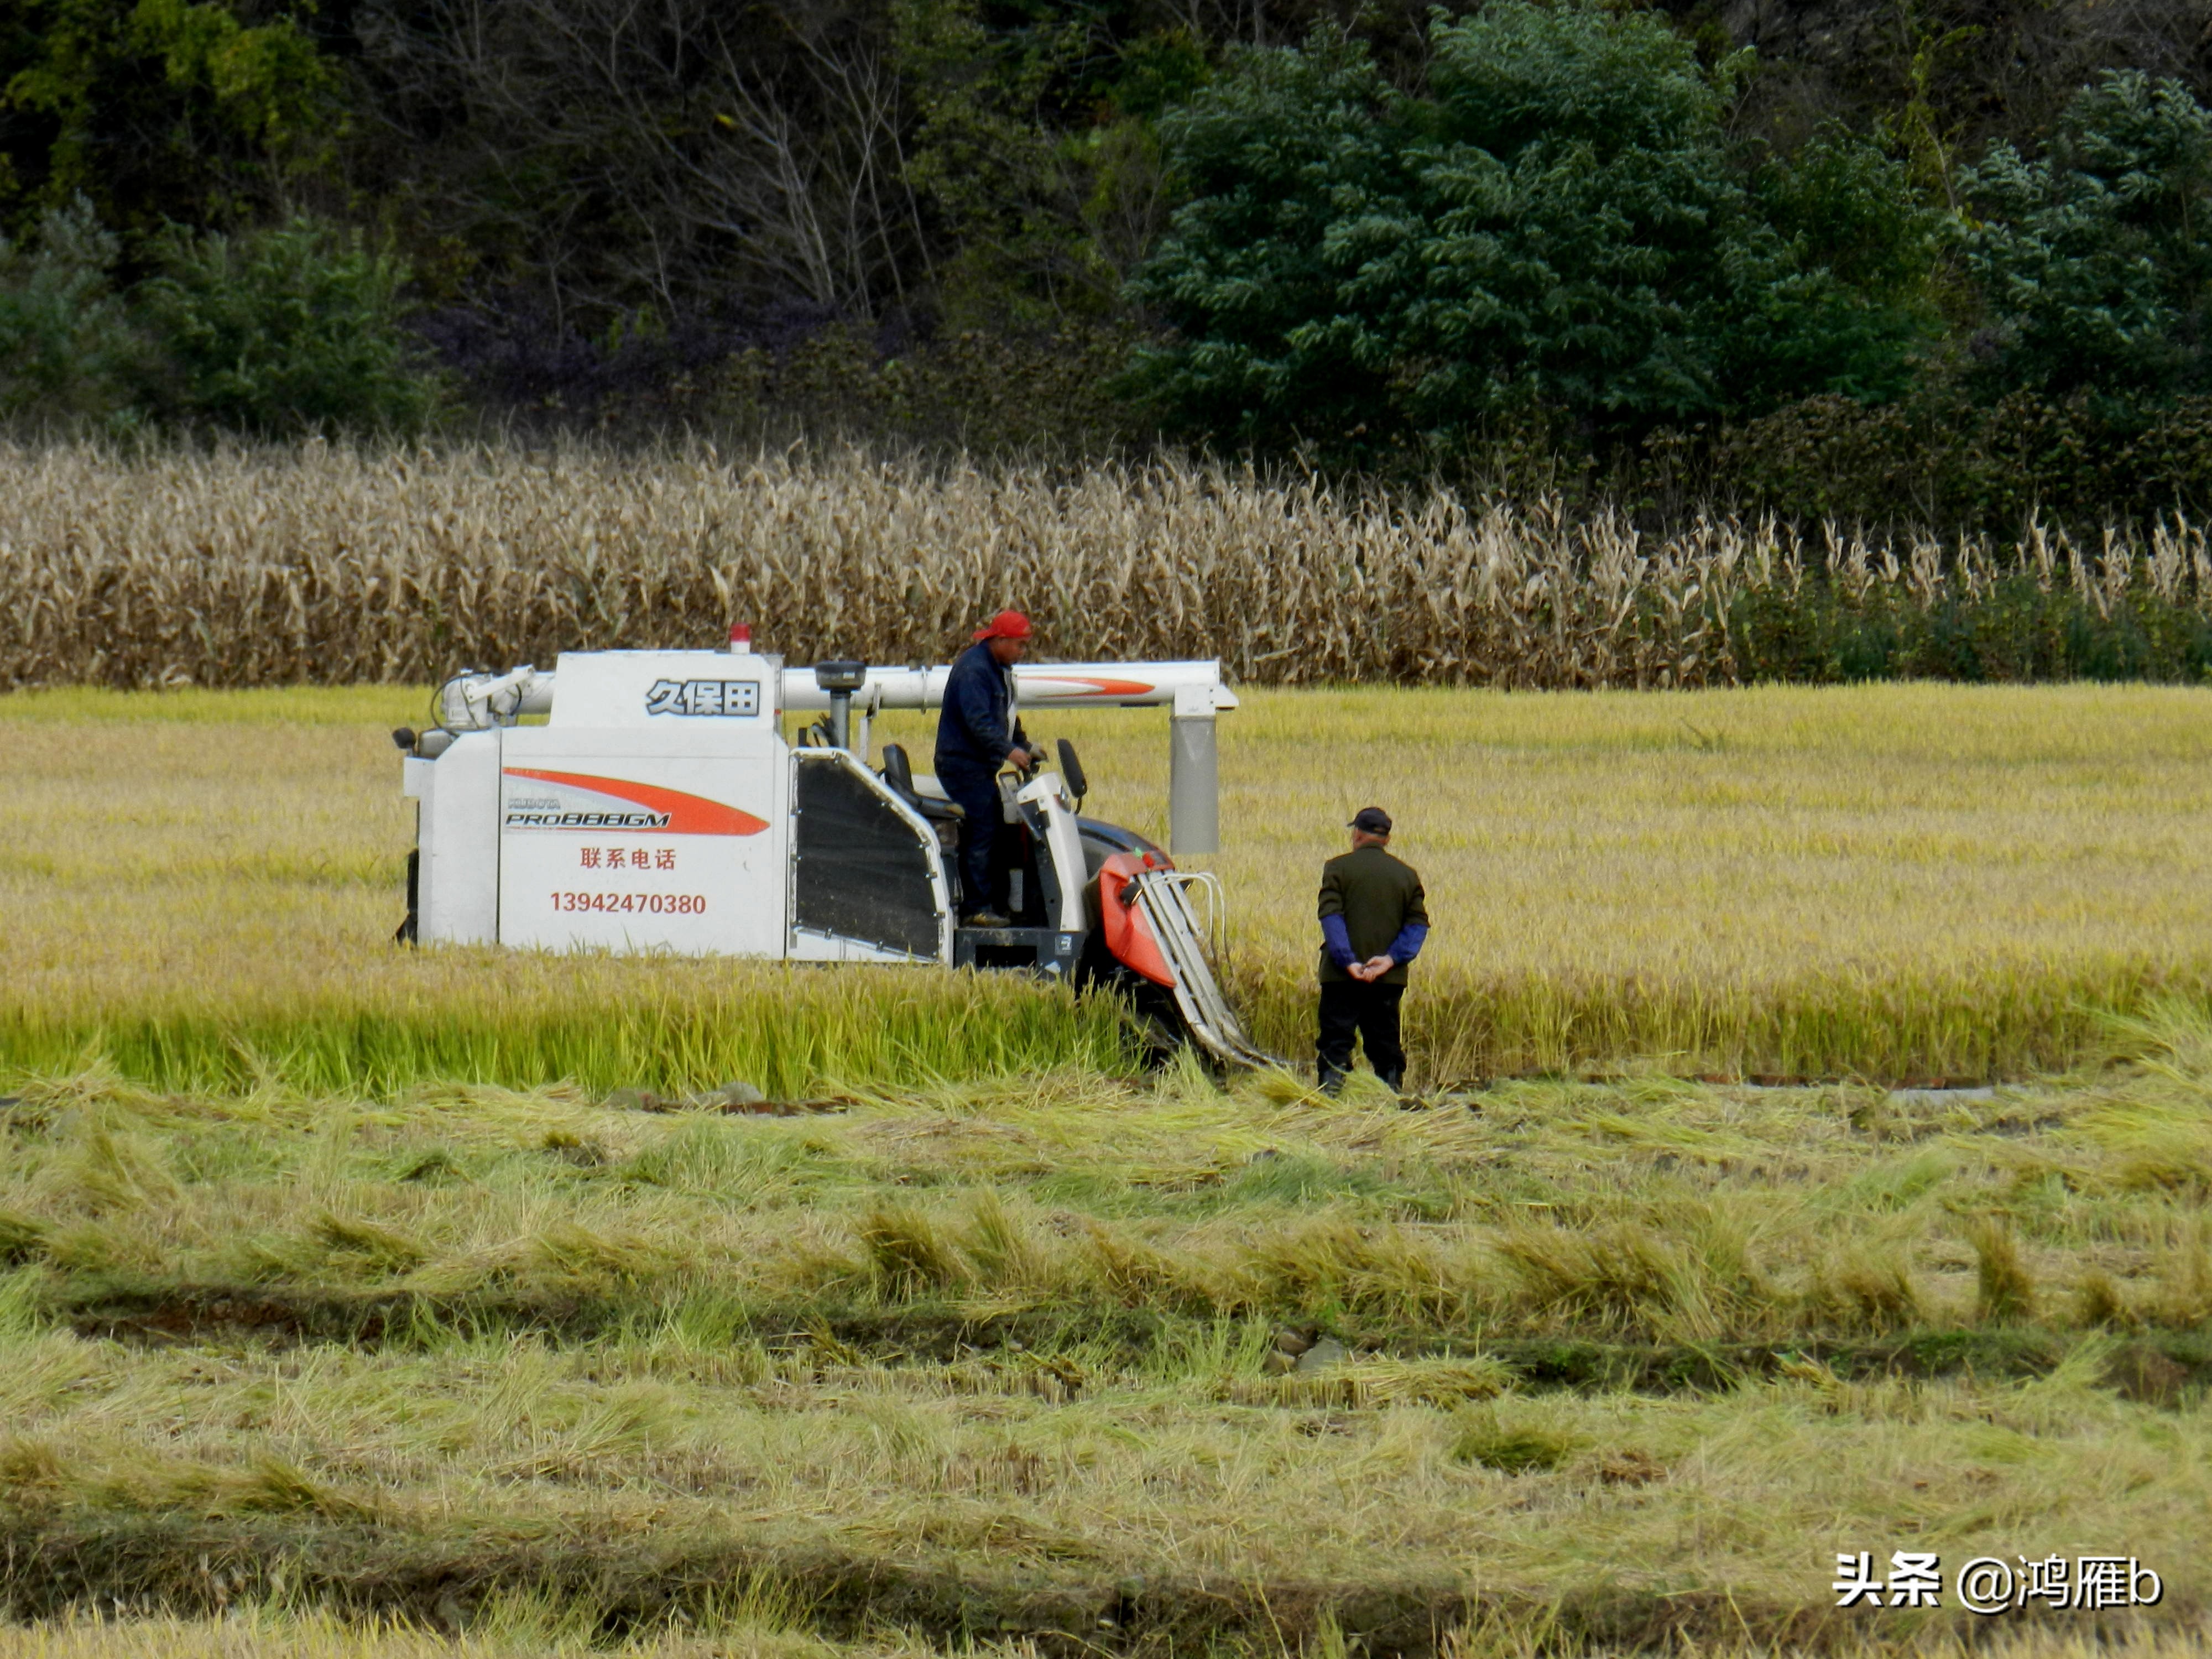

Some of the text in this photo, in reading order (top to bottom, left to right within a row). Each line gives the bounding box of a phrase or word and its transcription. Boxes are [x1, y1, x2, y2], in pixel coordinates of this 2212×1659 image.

[646, 680, 760, 716] 久保田
[506, 813, 671, 827] PRO888GM
[580, 848, 676, 870] 联系电话
[551, 892, 706, 914] 13942470380
